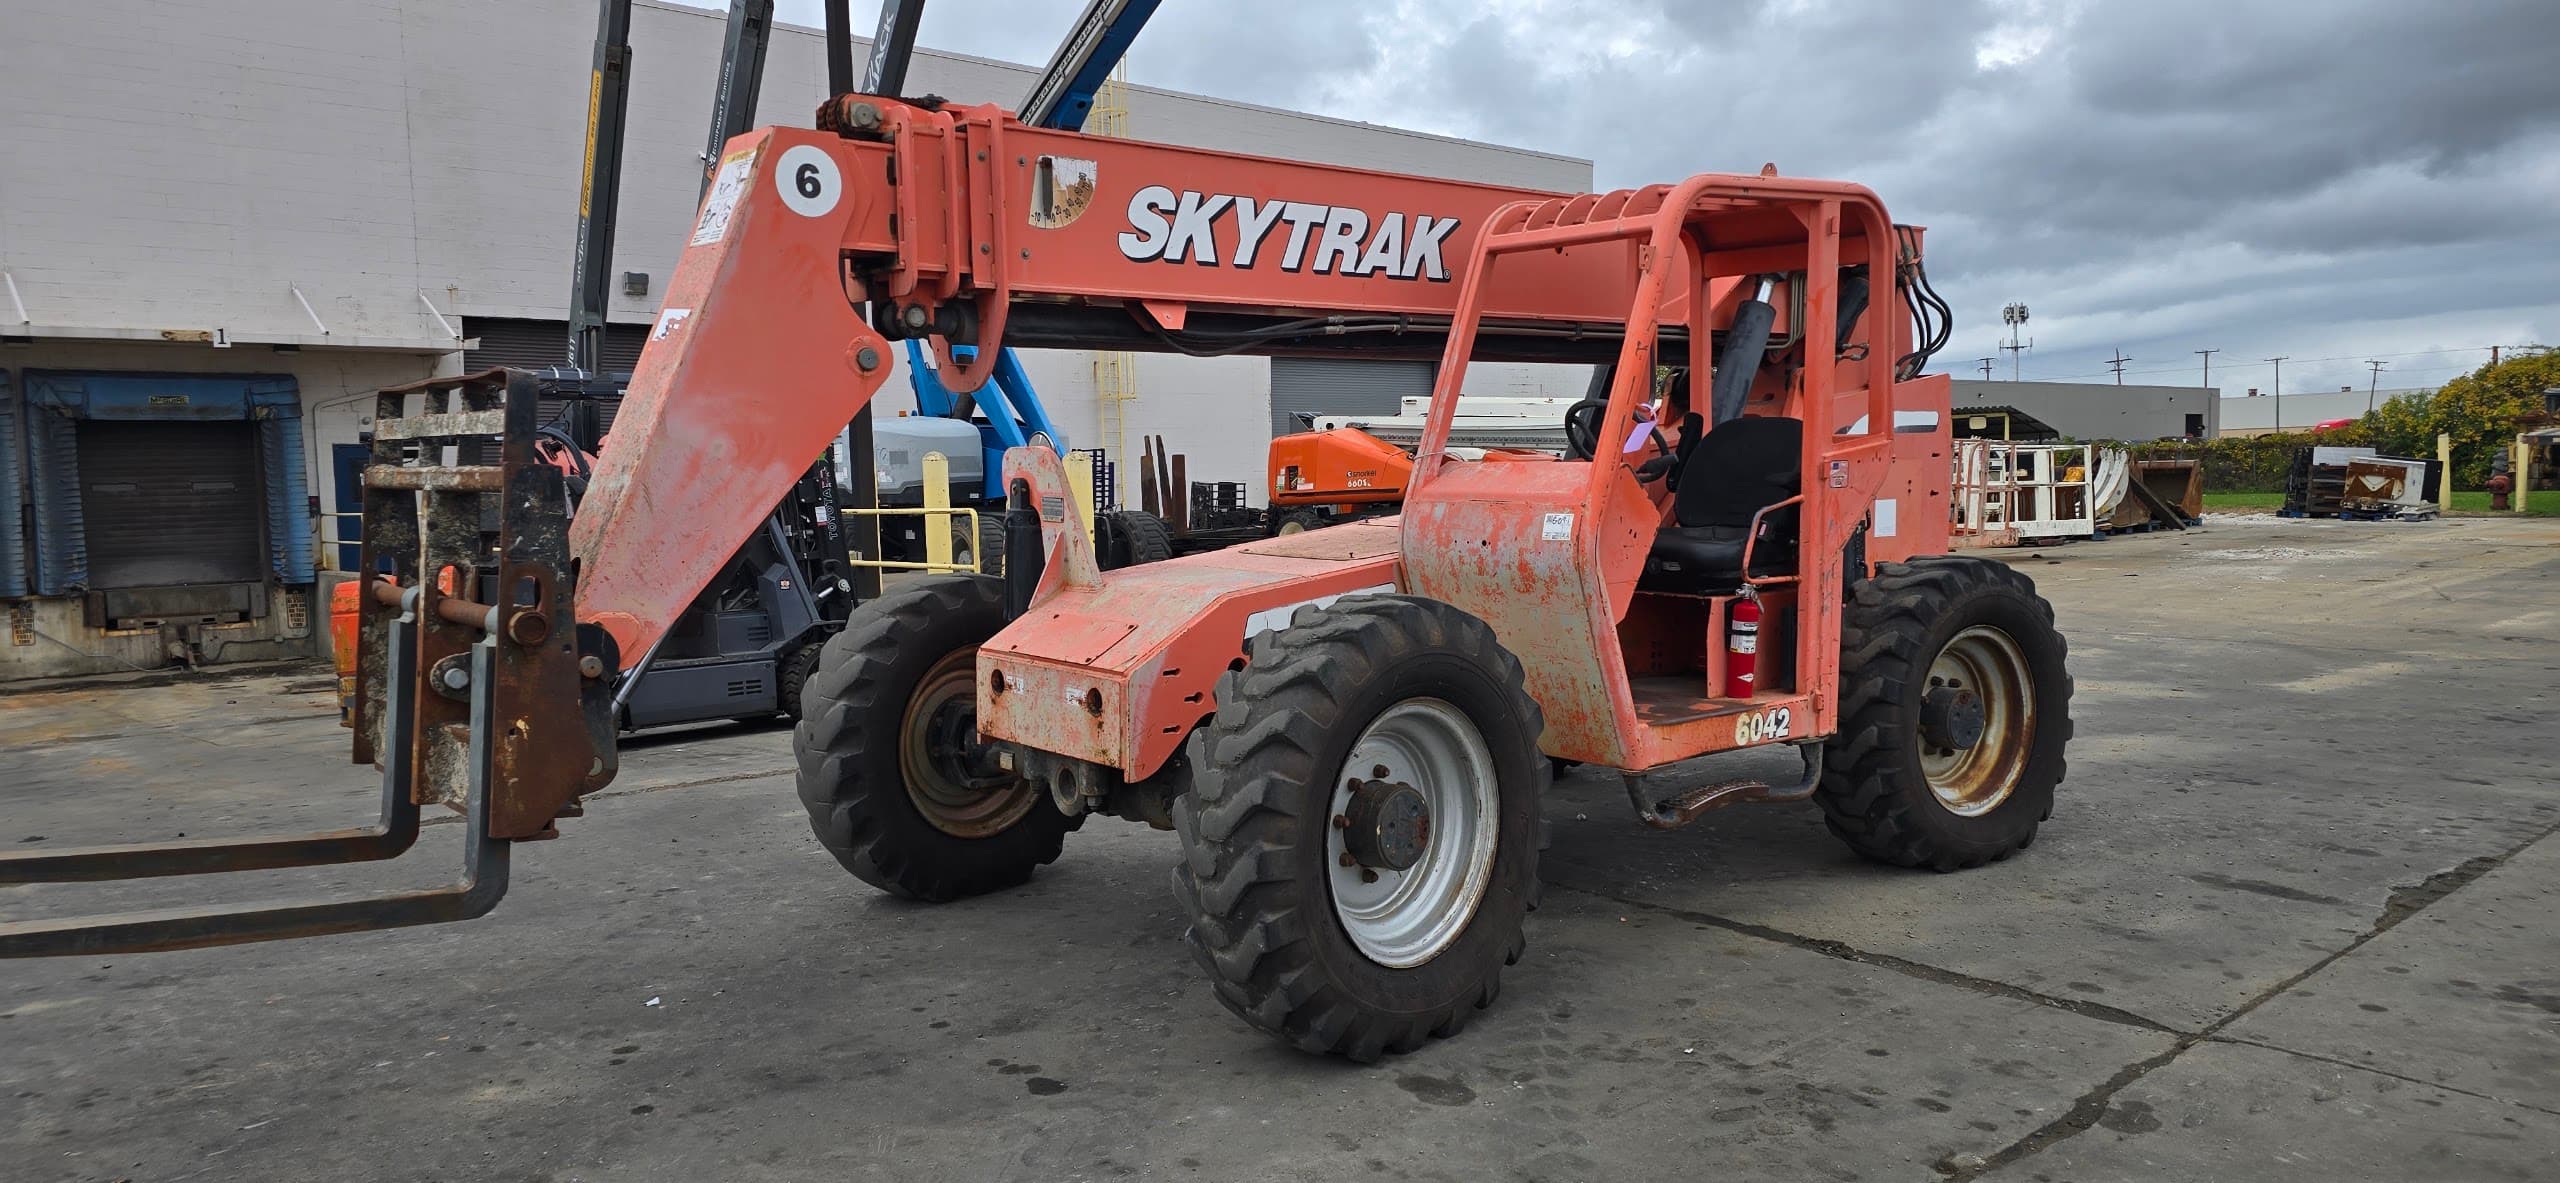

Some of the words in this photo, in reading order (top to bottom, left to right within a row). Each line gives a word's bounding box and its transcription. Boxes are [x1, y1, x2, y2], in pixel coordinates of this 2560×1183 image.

[795, 163, 821, 199] 6
[1117, 184, 1461, 283] SKYTRAK
[216, 327, 227, 345] 1
[1735, 707, 1791, 746] 6042
